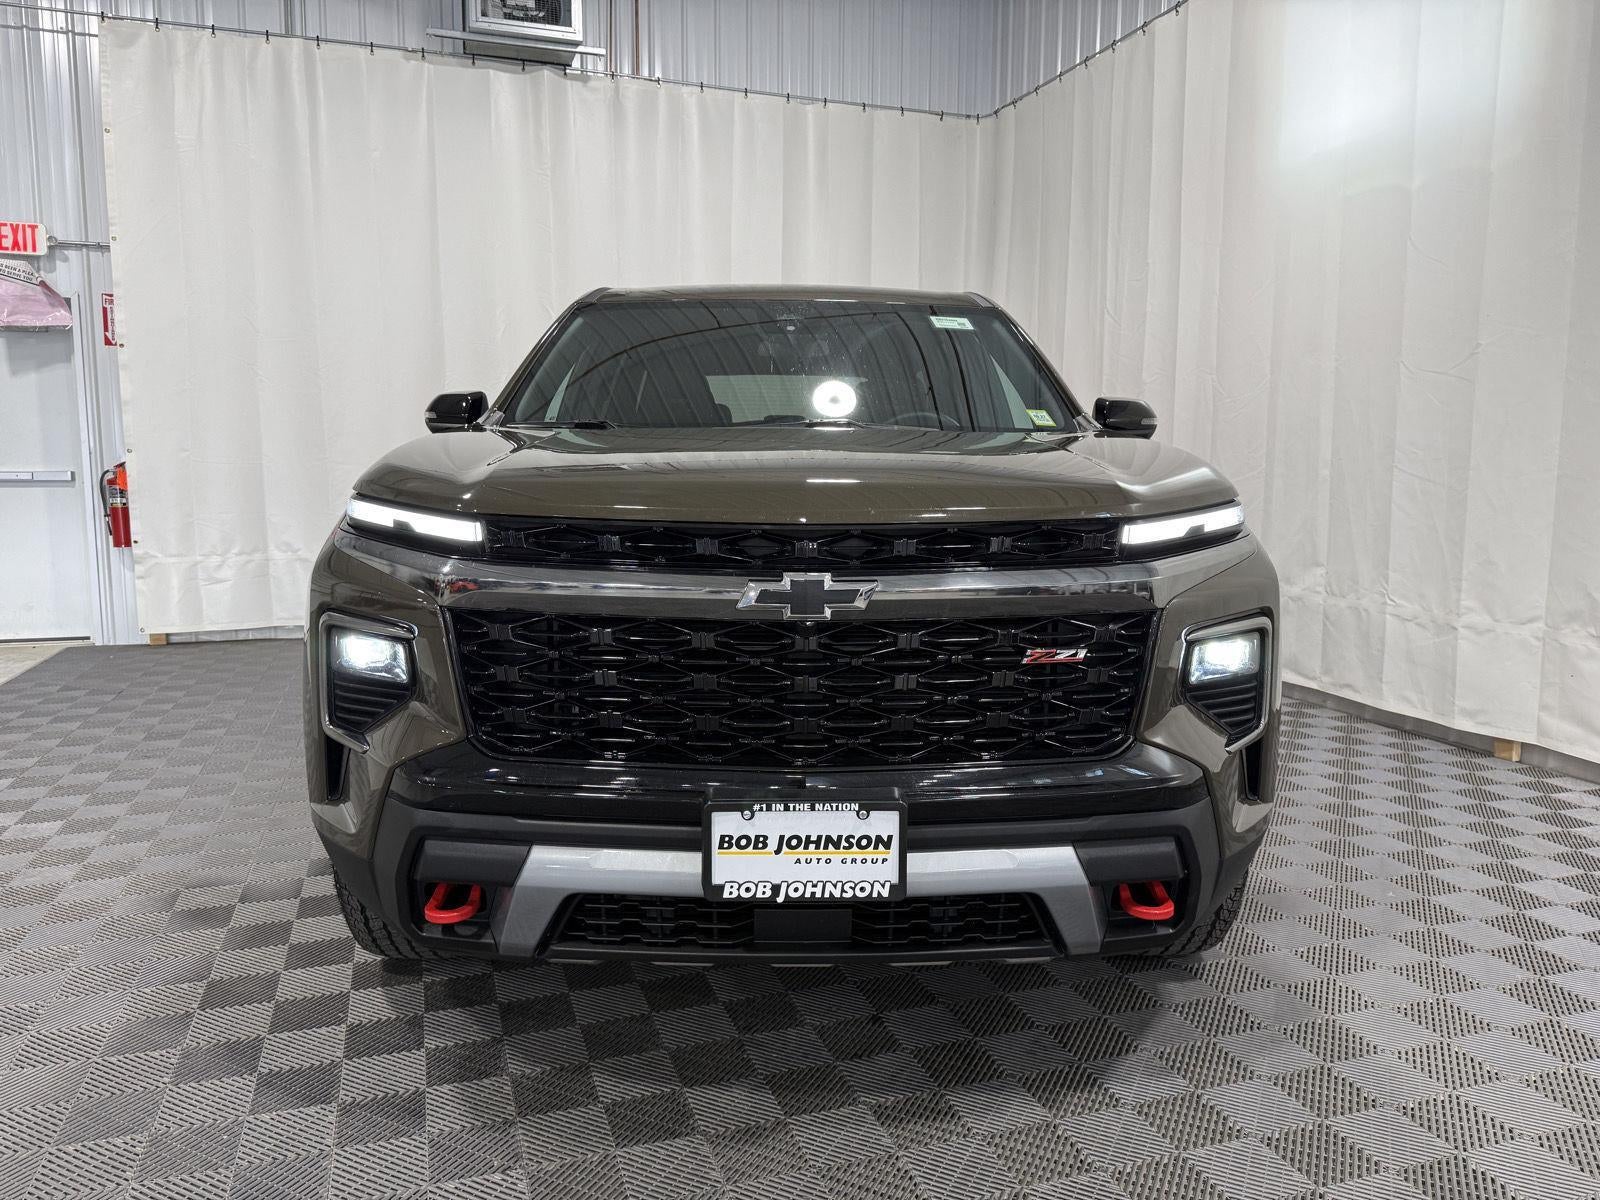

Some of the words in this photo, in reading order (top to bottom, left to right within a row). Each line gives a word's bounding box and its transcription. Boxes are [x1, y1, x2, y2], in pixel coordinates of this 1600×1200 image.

[0, 223, 38, 253] EXIT
[1021, 649, 1088, 663] Z71
[815, 803, 859, 811] NATION
[717, 834, 769, 850] BOB
[774, 834, 894, 855] JOHNSON
[722, 881, 773, 899] BOB
[776, 881, 891, 903] JOHNSON
